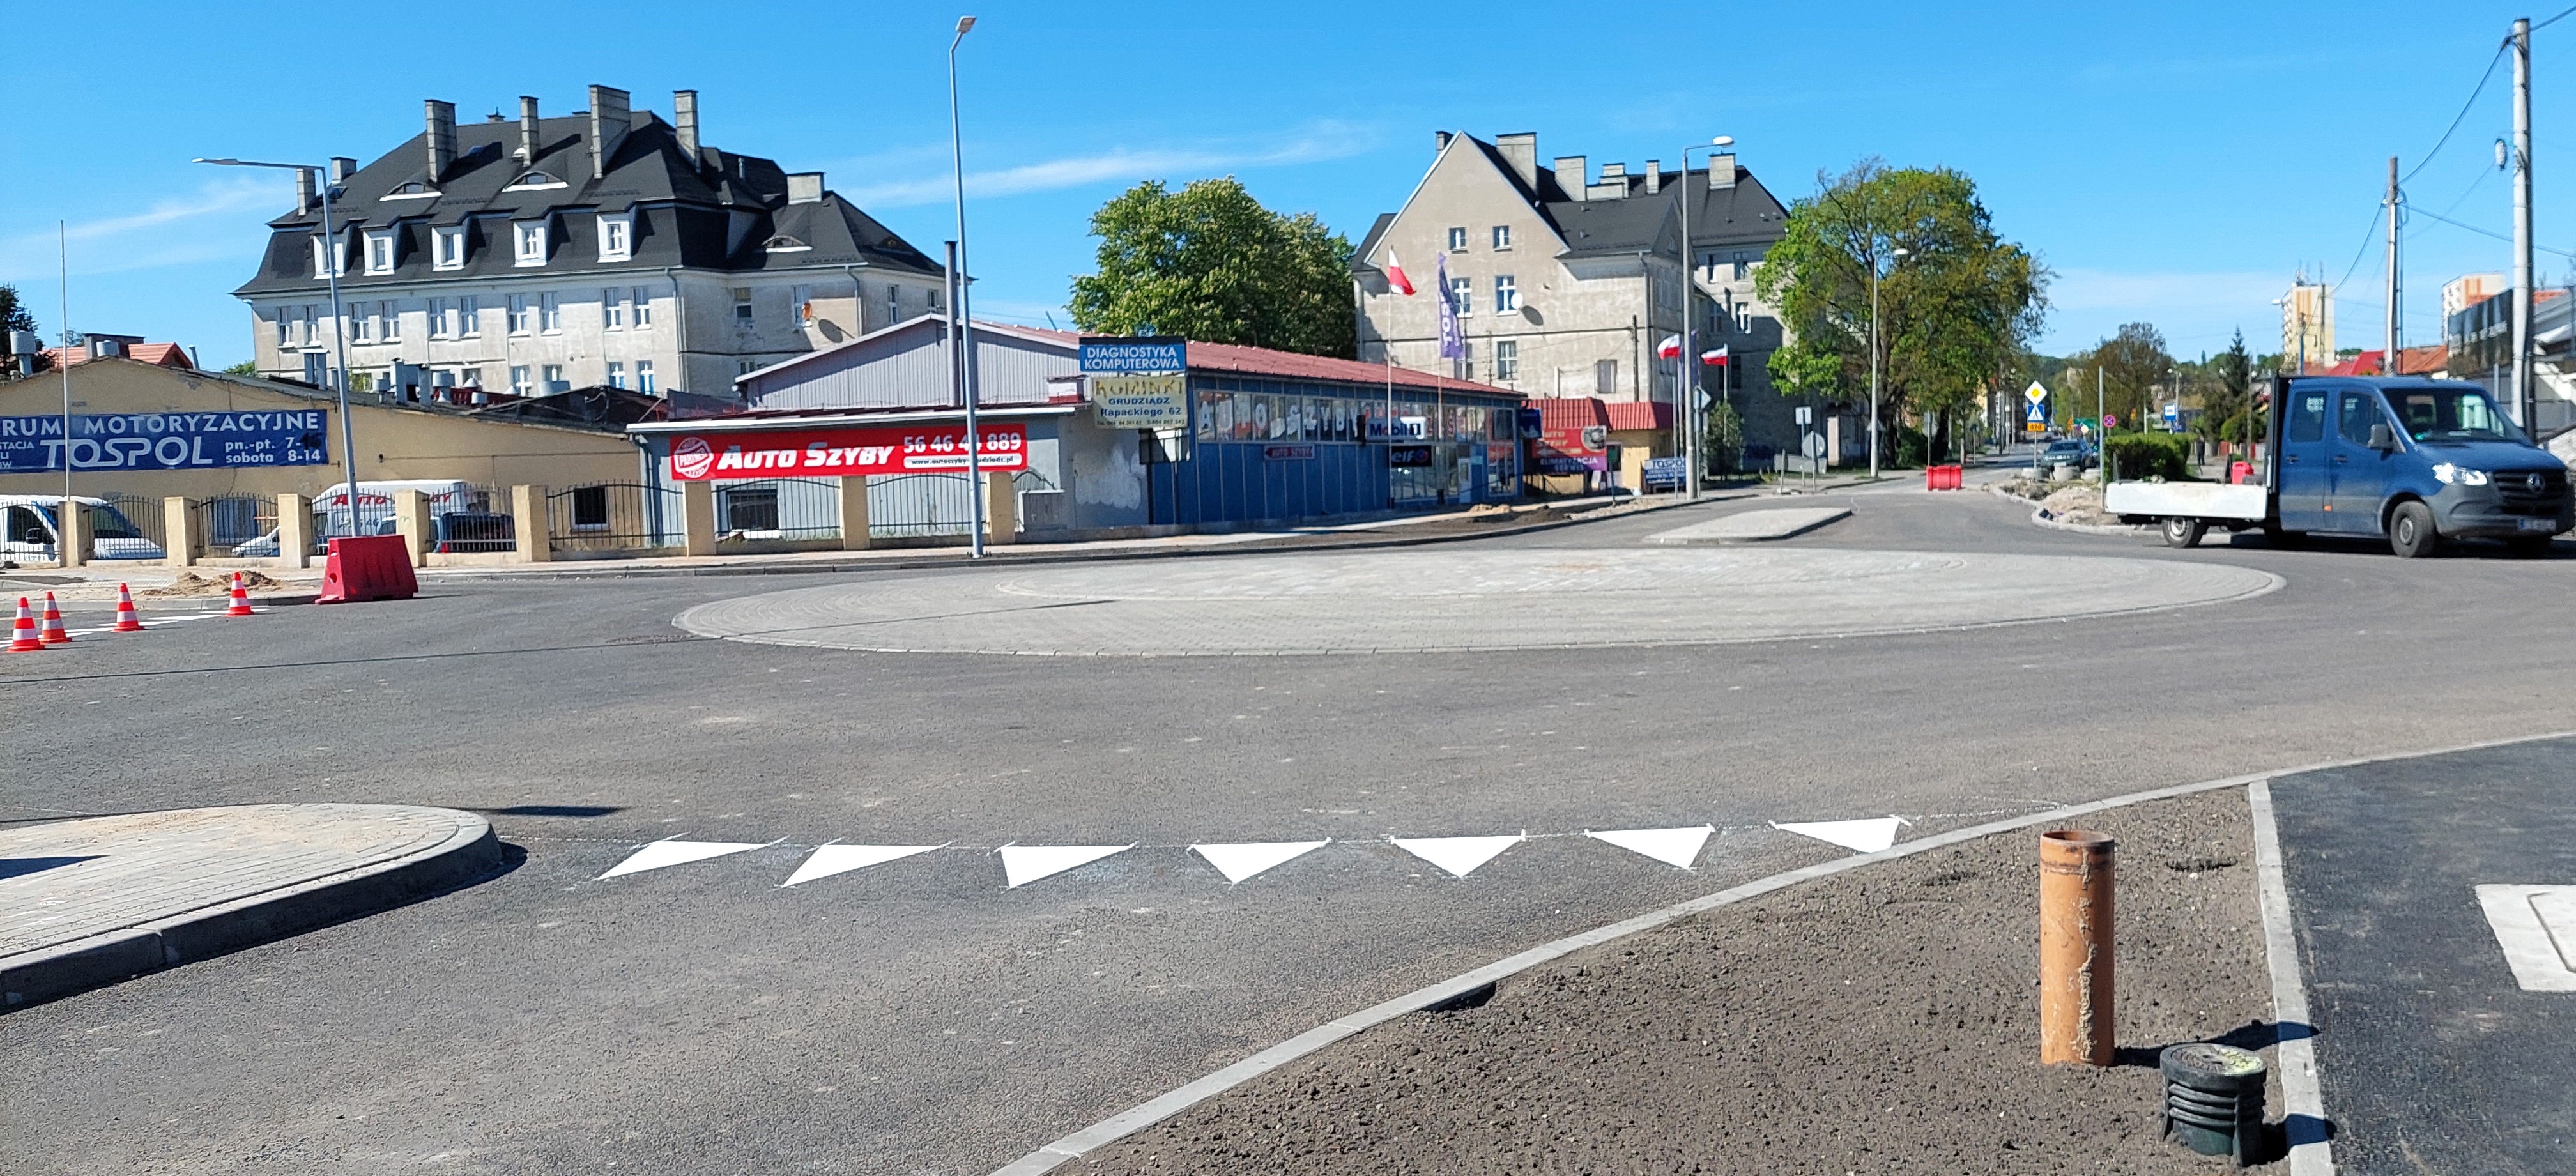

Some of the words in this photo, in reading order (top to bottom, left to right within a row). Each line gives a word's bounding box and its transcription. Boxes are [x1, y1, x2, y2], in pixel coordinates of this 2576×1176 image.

[1087, 347, 1177, 358] DIAGNOSTYKA
[1084, 358, 1180, 370] KOMPUTEROWA
[1100, 408, 1163, 418] Rapackiego
[1169, 407, 1182, 416] 62
[84, 412, 319, 434] MOTORYZACYJNE
[1369, 422, 1406, 436] Mobil
[0, 441, 35, 450] TACJA
[39, 436, 213, 468] TOSPOL
[225, 439, 275, 452] pn.-pt.
[716, 444, 797, 470] AUTO
[803, 441, 895, 468] SZYBY
[903, 435, 926, 454] 56
[930, 434, 954, 453] 46
[986, 432, 1022, 451] 889
[225, 452, 274, 464] sobota
[288, 448, 321, 462] 8-14
[1391, 449, 1414, 464] elf
